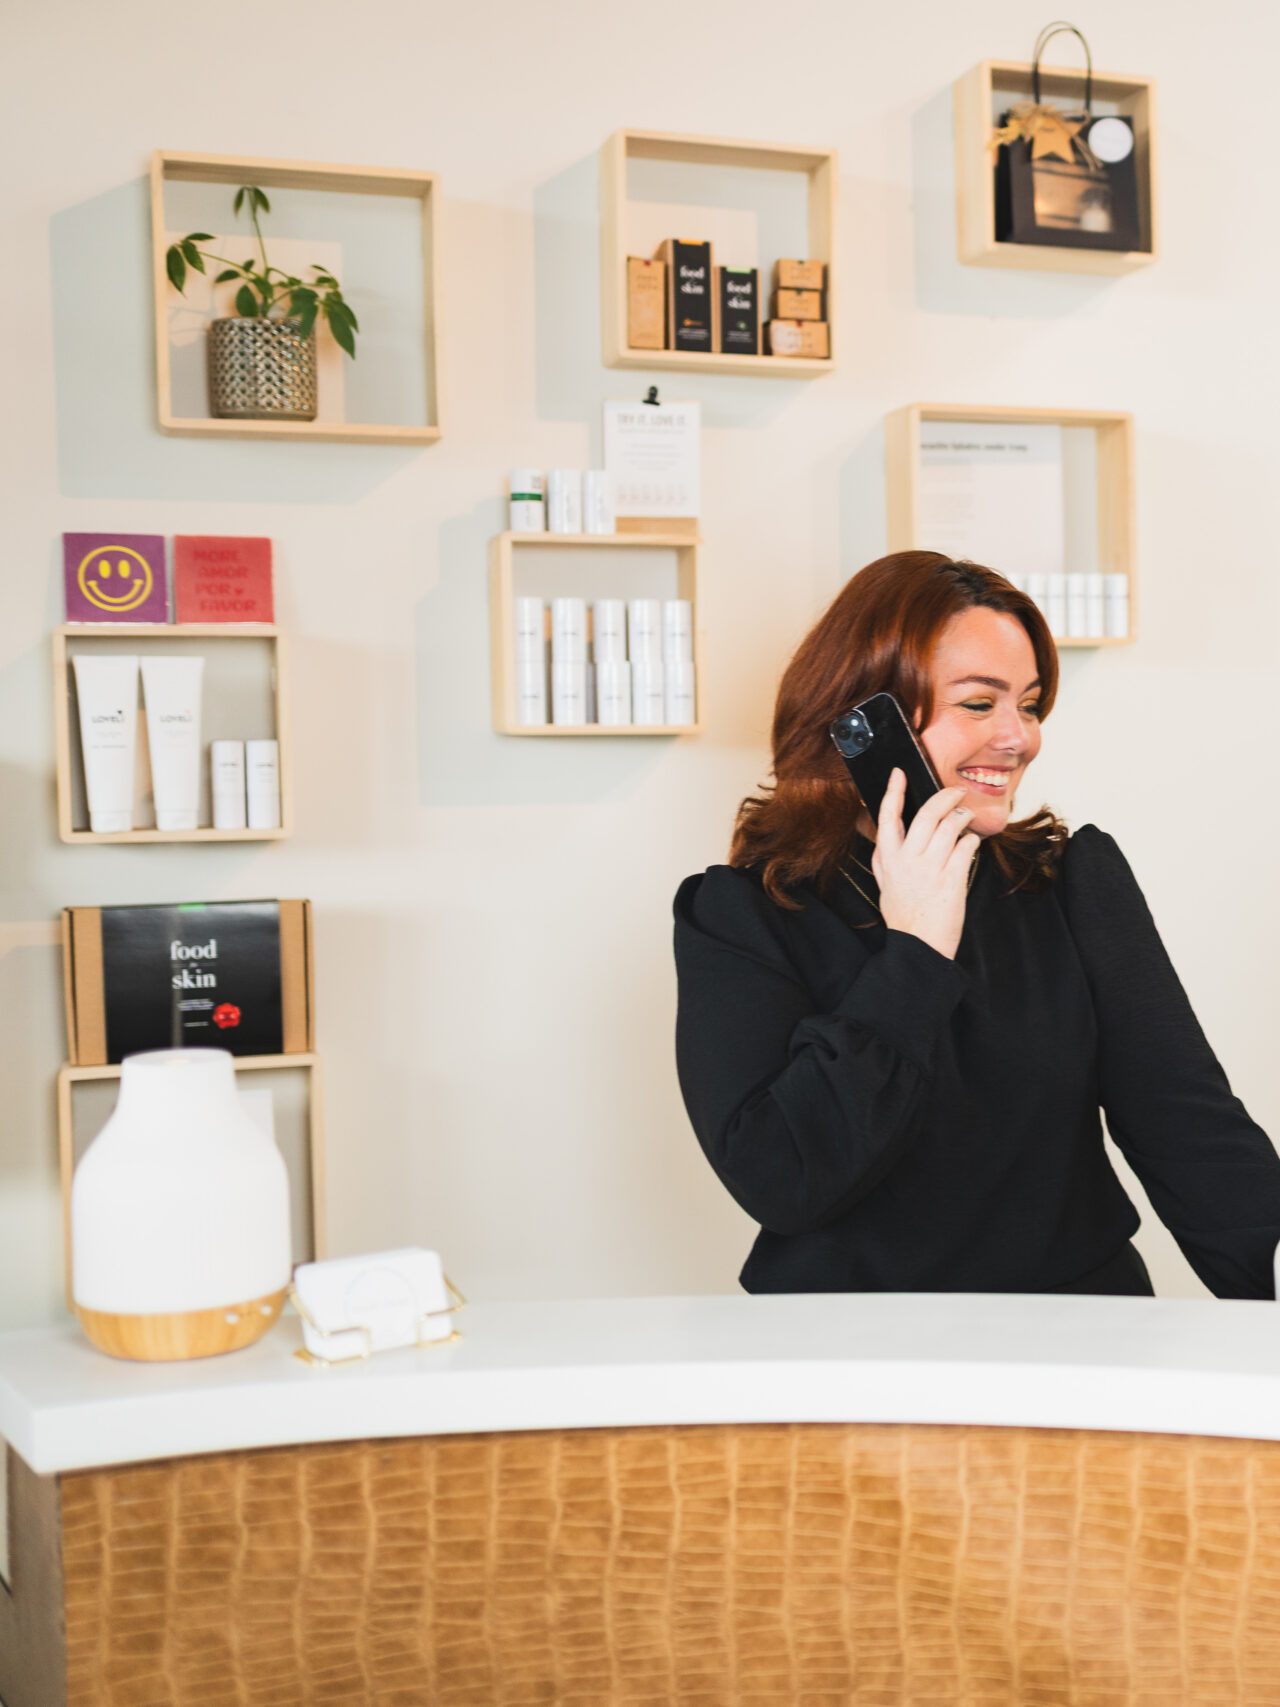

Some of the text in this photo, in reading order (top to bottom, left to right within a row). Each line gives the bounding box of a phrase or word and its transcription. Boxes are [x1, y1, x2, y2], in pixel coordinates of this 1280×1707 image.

[680, 265, 705, 279] food
[680, 282, 705, 295] skin
[726, 280, 752, 294] food
[727, 296, 752, 310] skin
[193, 549, 240, 562] MORE
[198, 566, 248, 578] AMOR
[195, 582, 231, 595] POR
[200, 598, 257, 612] FAVOR
[170, 938, 218, 961] food
[171, 968, 218, 990] skin
